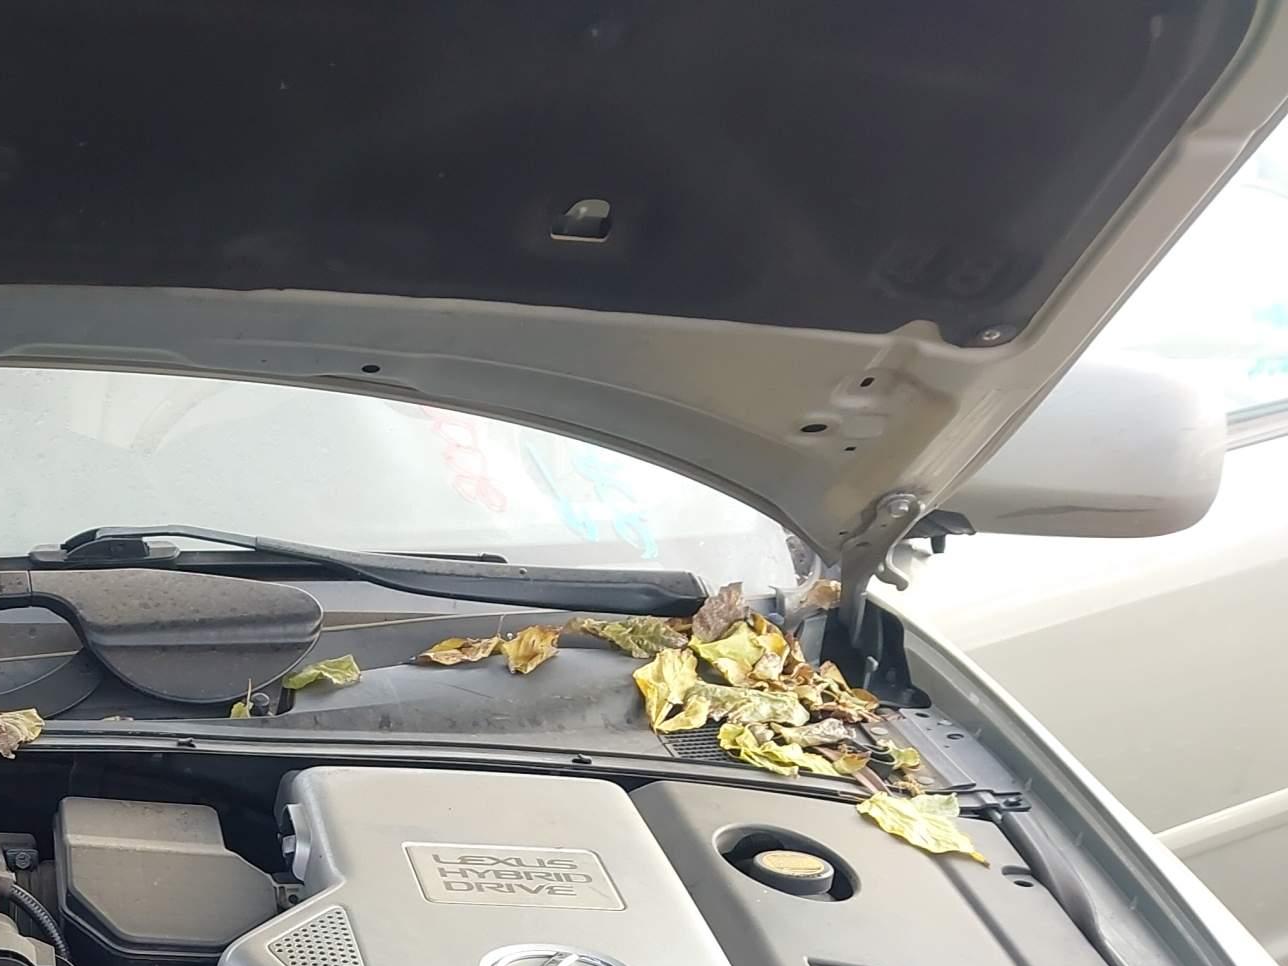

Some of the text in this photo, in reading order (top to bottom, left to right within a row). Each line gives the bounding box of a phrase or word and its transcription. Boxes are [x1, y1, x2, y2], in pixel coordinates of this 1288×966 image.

[432, 854, 578, 870] LEXUS
[438, 867, 593, 883] HYBRID
[443, 880, 577, 896] DRIVE
